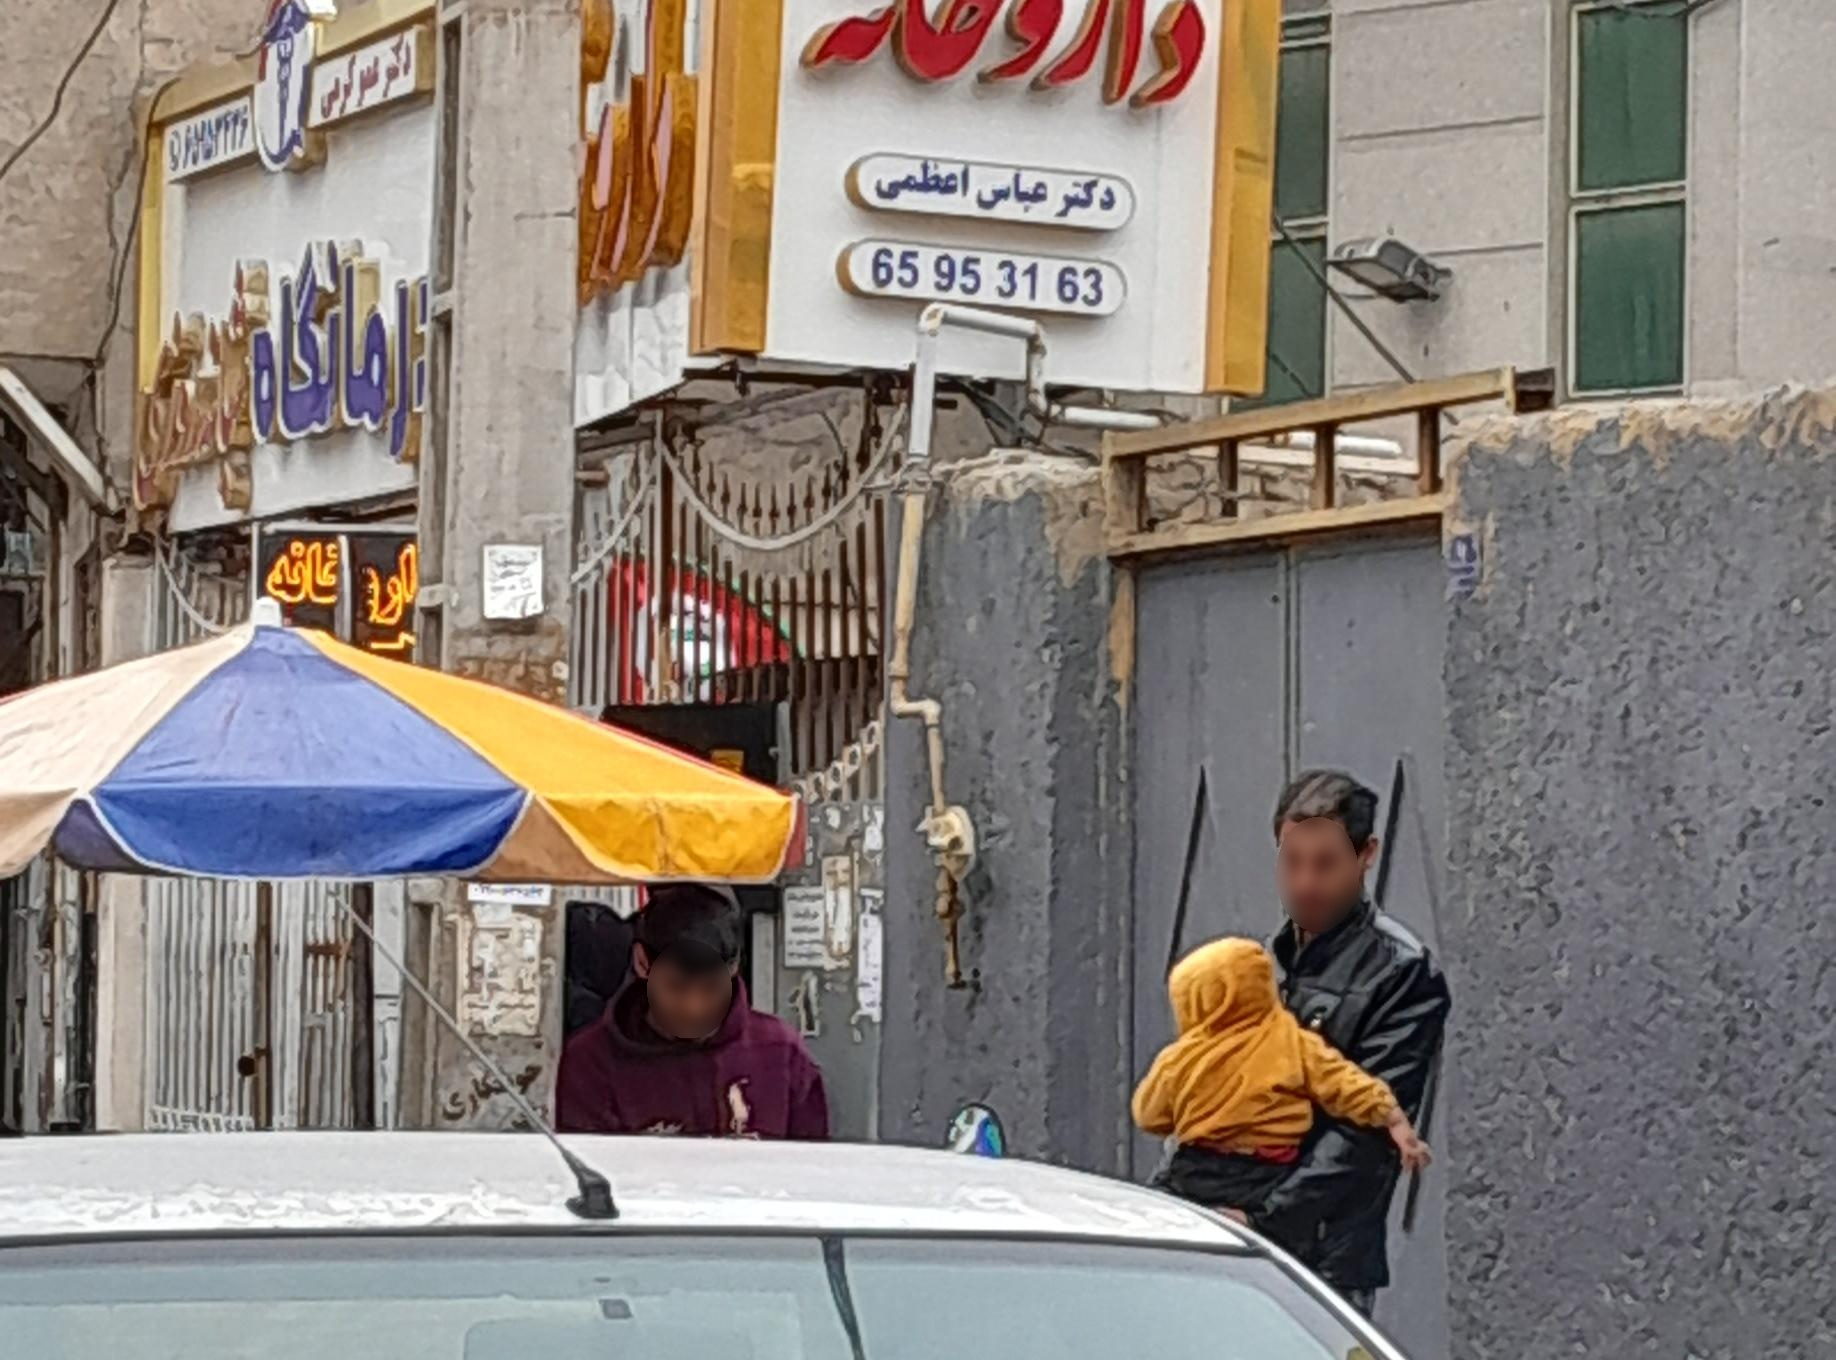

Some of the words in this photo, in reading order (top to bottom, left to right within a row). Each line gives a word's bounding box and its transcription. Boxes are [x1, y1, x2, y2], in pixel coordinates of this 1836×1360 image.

[874, 160, 970, 200] اعظمی
[976, 172, 1048, 213] عباس
[1055, 176, 1116, 217] دکتر
[872, 247, 920, 289] 65
[933, 253, 982, 295] 95
[996, 259, 1039, 300] 31
[1056, 266, 1103, 306] 63
[250, 238, 428, 463] رمانگاه
